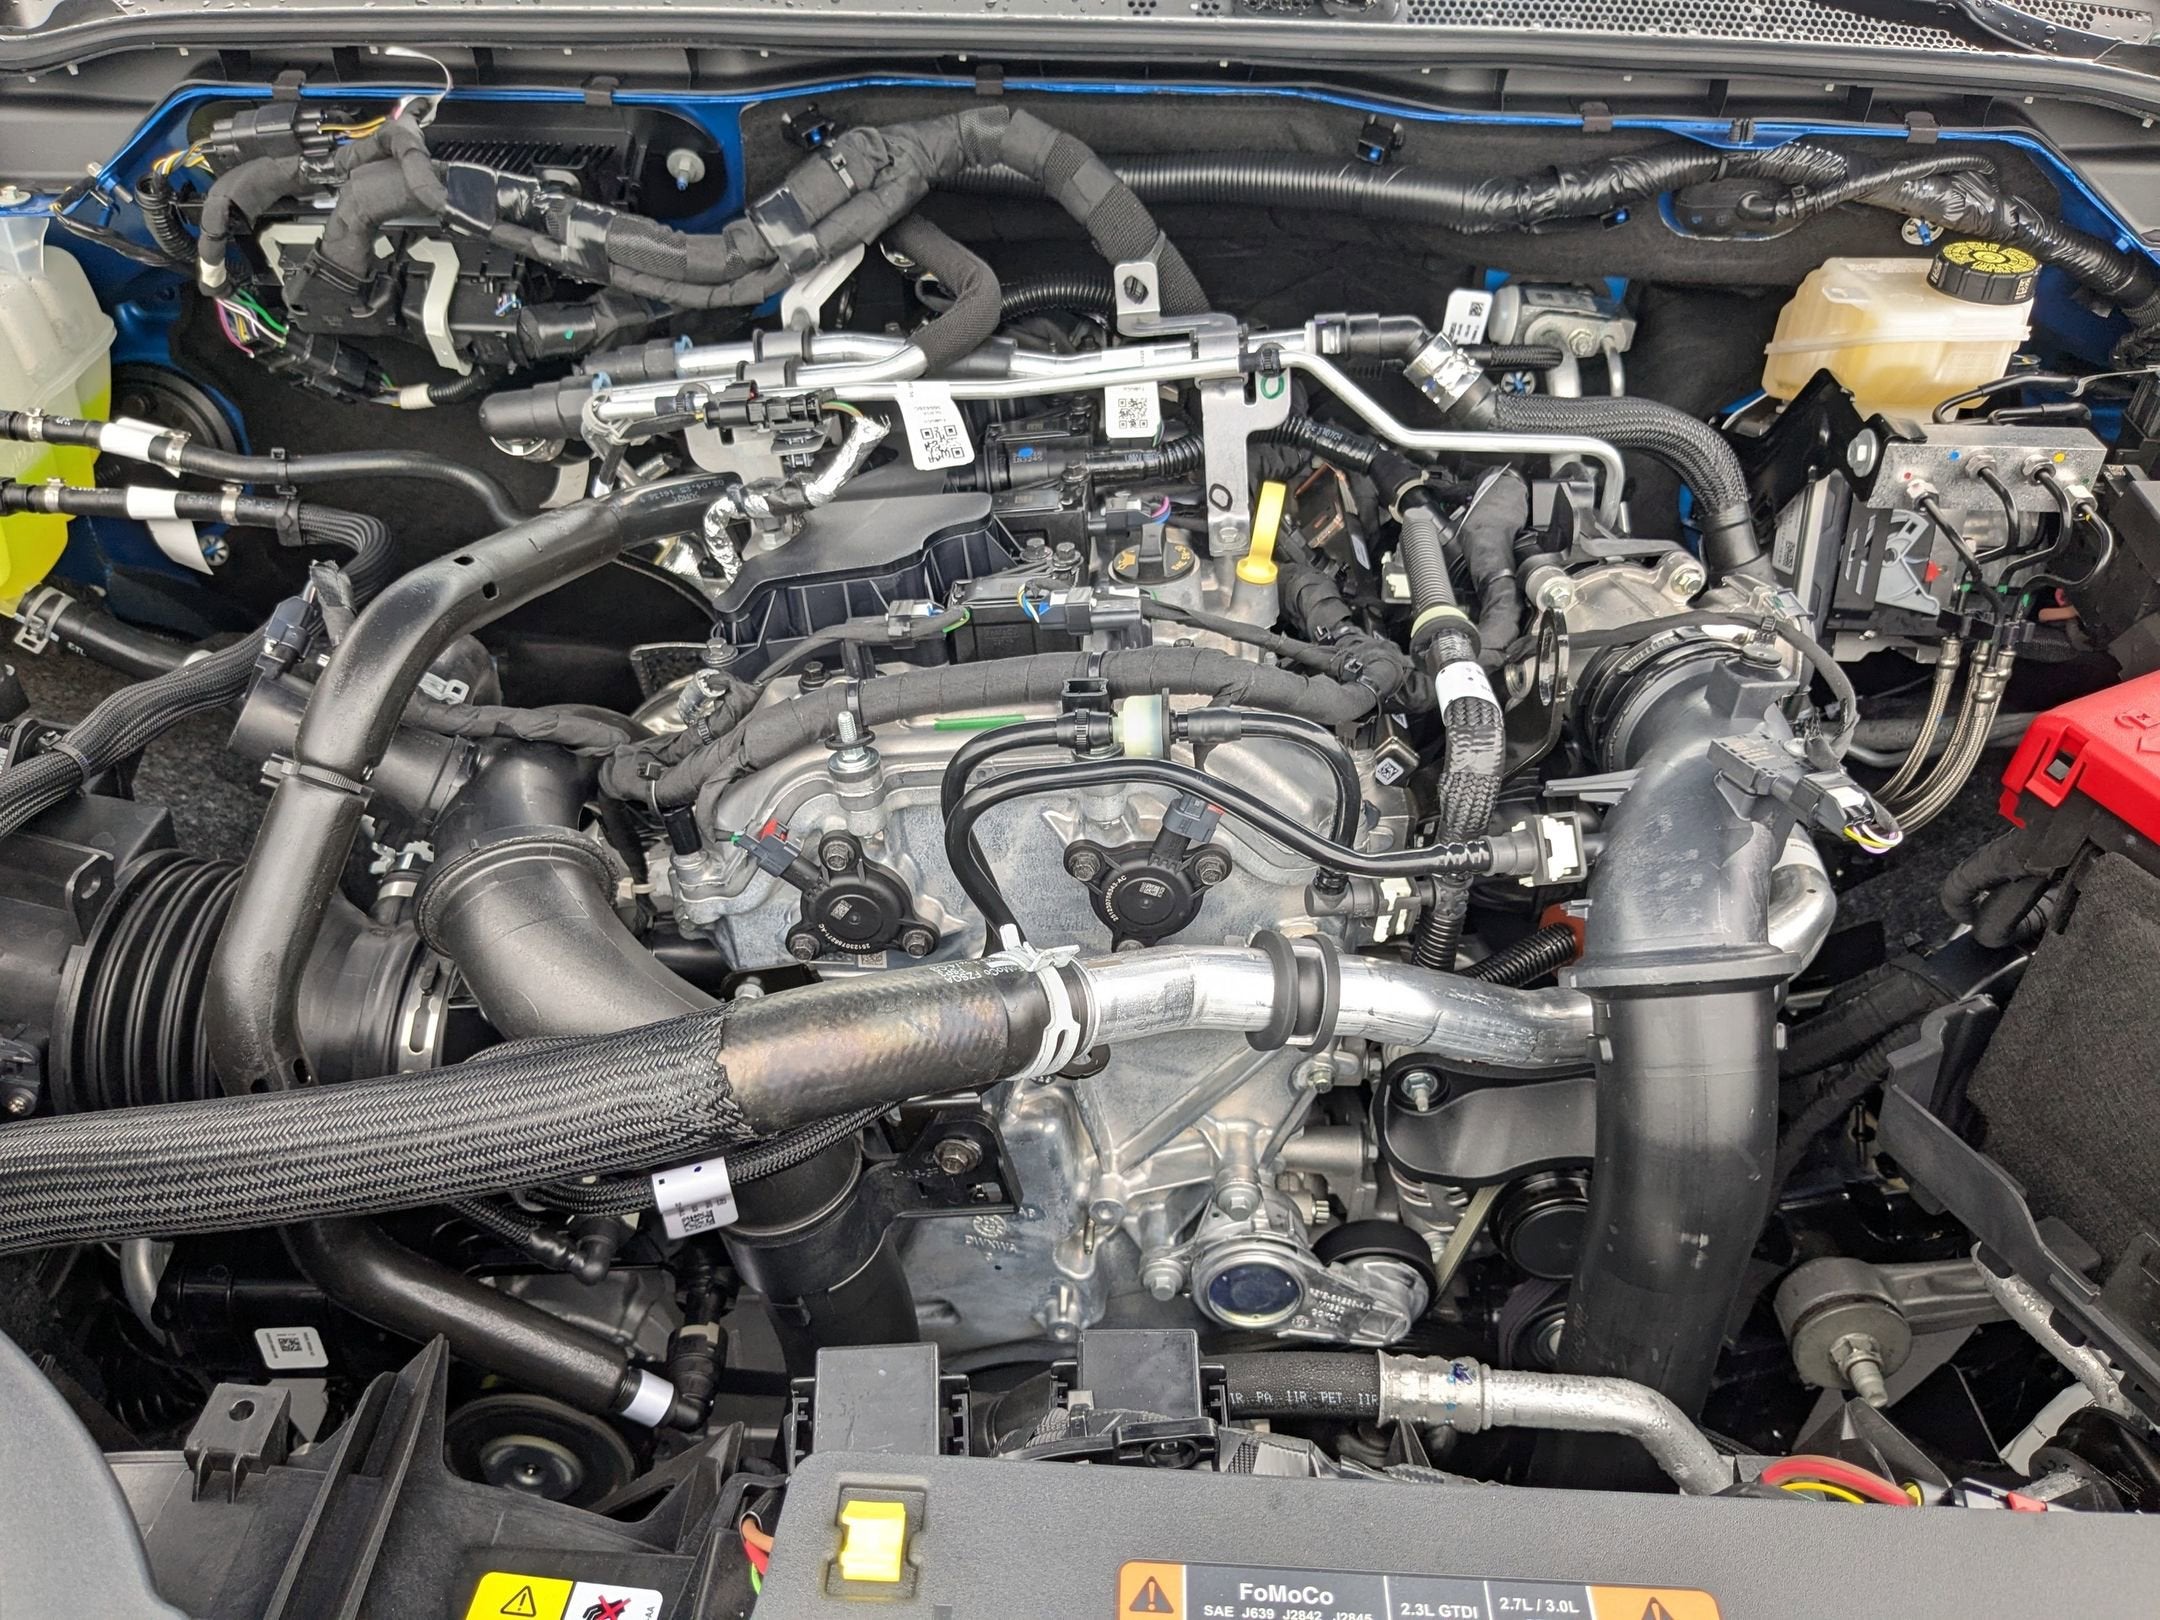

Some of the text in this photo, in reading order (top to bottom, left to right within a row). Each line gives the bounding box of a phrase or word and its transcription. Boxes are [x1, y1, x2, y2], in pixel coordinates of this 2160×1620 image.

[1239, 1582, 1334, 1606] FoMoCo
[1203, 1605, 1235, 1617] SAE
[1242, 1607, 1275, 1619] J639
[1282, 1609, 1322, 1620] J2842
[1400, 1602, 1478, 1619] 2.3L GTDI
[1499, 1597, 1533, 1611] 2.7L
[1545, 1599, 1580, 1613] 3.0L
